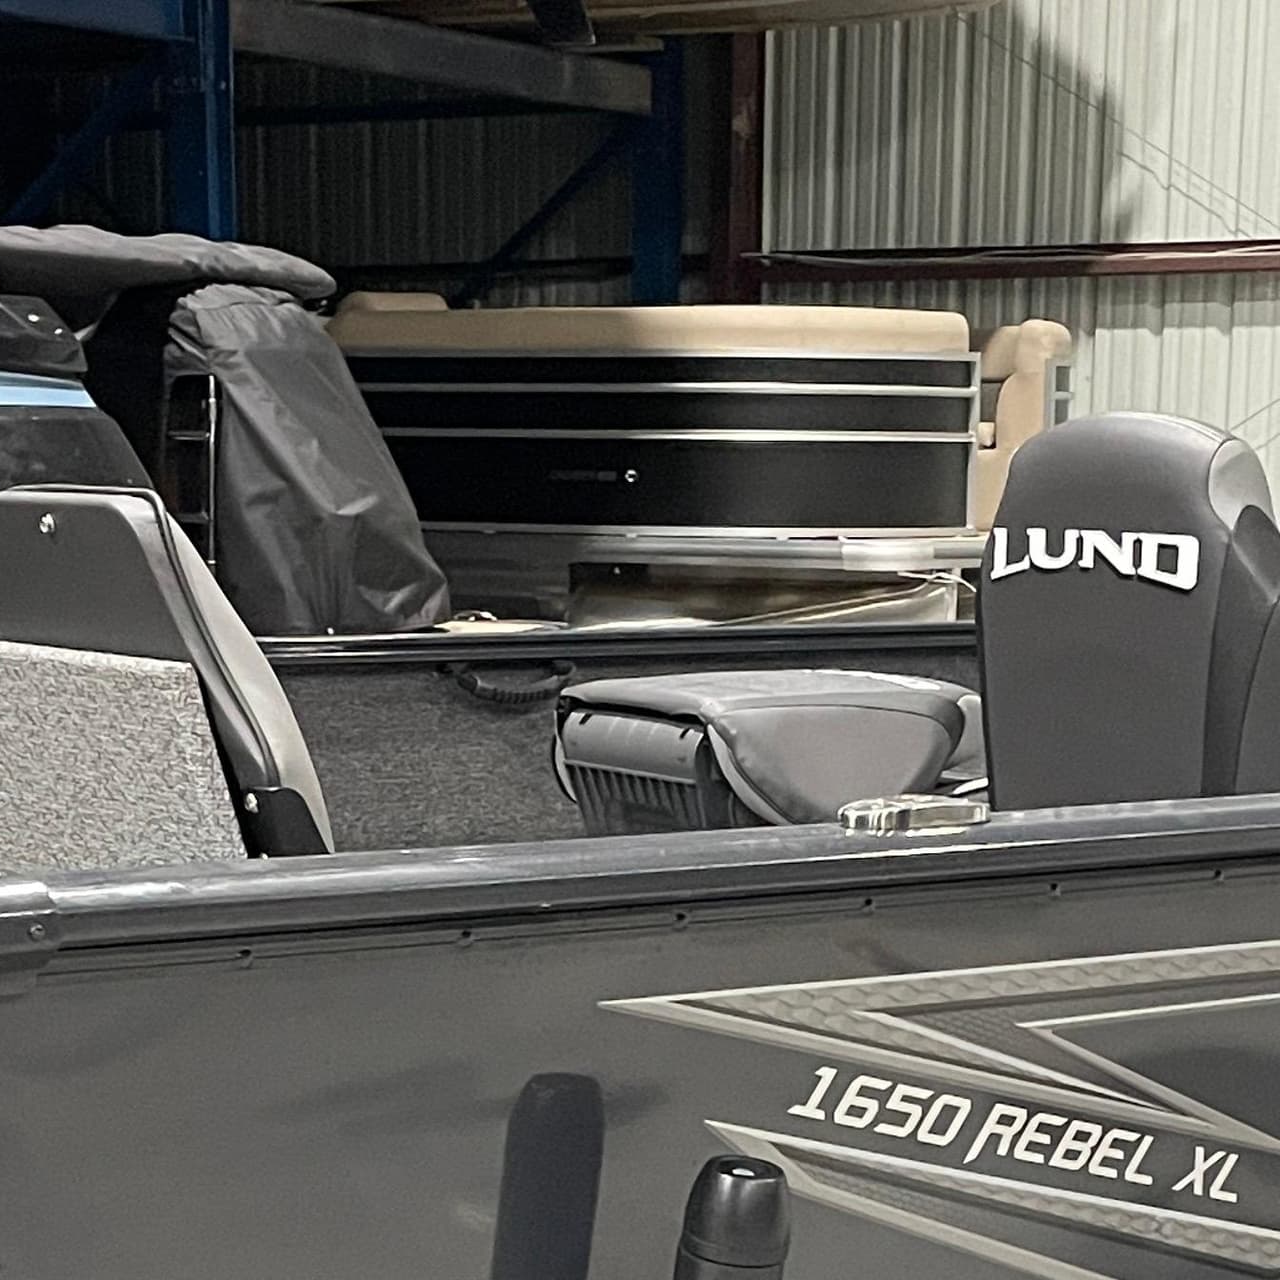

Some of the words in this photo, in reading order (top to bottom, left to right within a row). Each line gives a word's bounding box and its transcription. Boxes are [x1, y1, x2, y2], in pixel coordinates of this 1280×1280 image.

[991, 527, 1200, 591] LUND
[787, 1066, 972, 1148] 1650
[963, 1103, 1155, 1186] REBEL
[1173, 1146, 1238, 1204] XL
